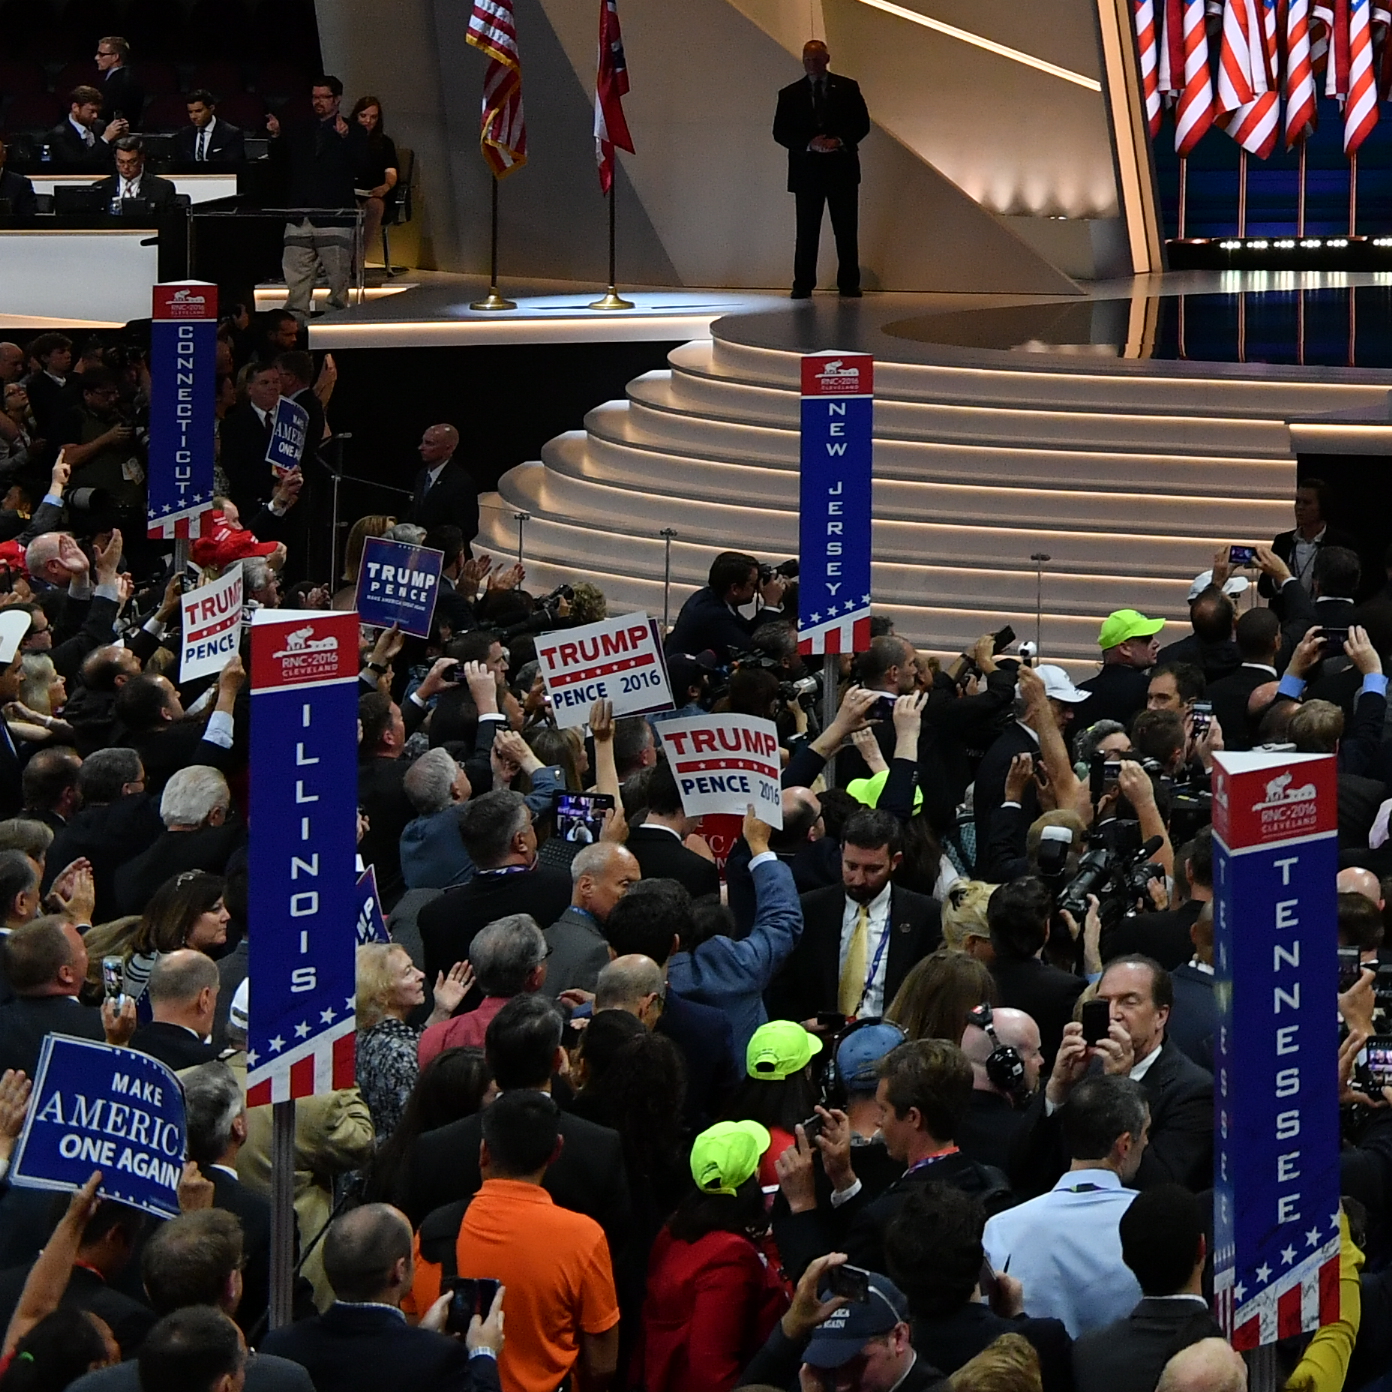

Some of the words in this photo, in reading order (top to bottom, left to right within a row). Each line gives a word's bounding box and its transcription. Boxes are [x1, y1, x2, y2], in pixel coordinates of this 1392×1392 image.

[175, 325, 195, 495] CONNECTICUT
[825, 402, 848, 457] NEW
[825, 480, 844, 597] JERSEY
[367, 561, 436, 590] TRUMP
[370, 581, 428, 603] PENCE
[185, 634, 235, 663] PENCE
[540, 625, 649, 671] TRUMP
[553, 682, 608, 710] PENCE
[620, 669, 661, 694] 2016
[664, 727, 777, 758] TRUMP
[681, 775, 751, 796] PENCE
[759, 780, 780, 806] 2016
[290, 704, 320, 994] ILLINOIS
[1273, 857, 1302, 1226] TENNESSEE
[111, 1071, 163, 1108] MAKE
[59, 1133, 116, 1167] ONE
[117, 1150, 181, 1191] AGAIN
